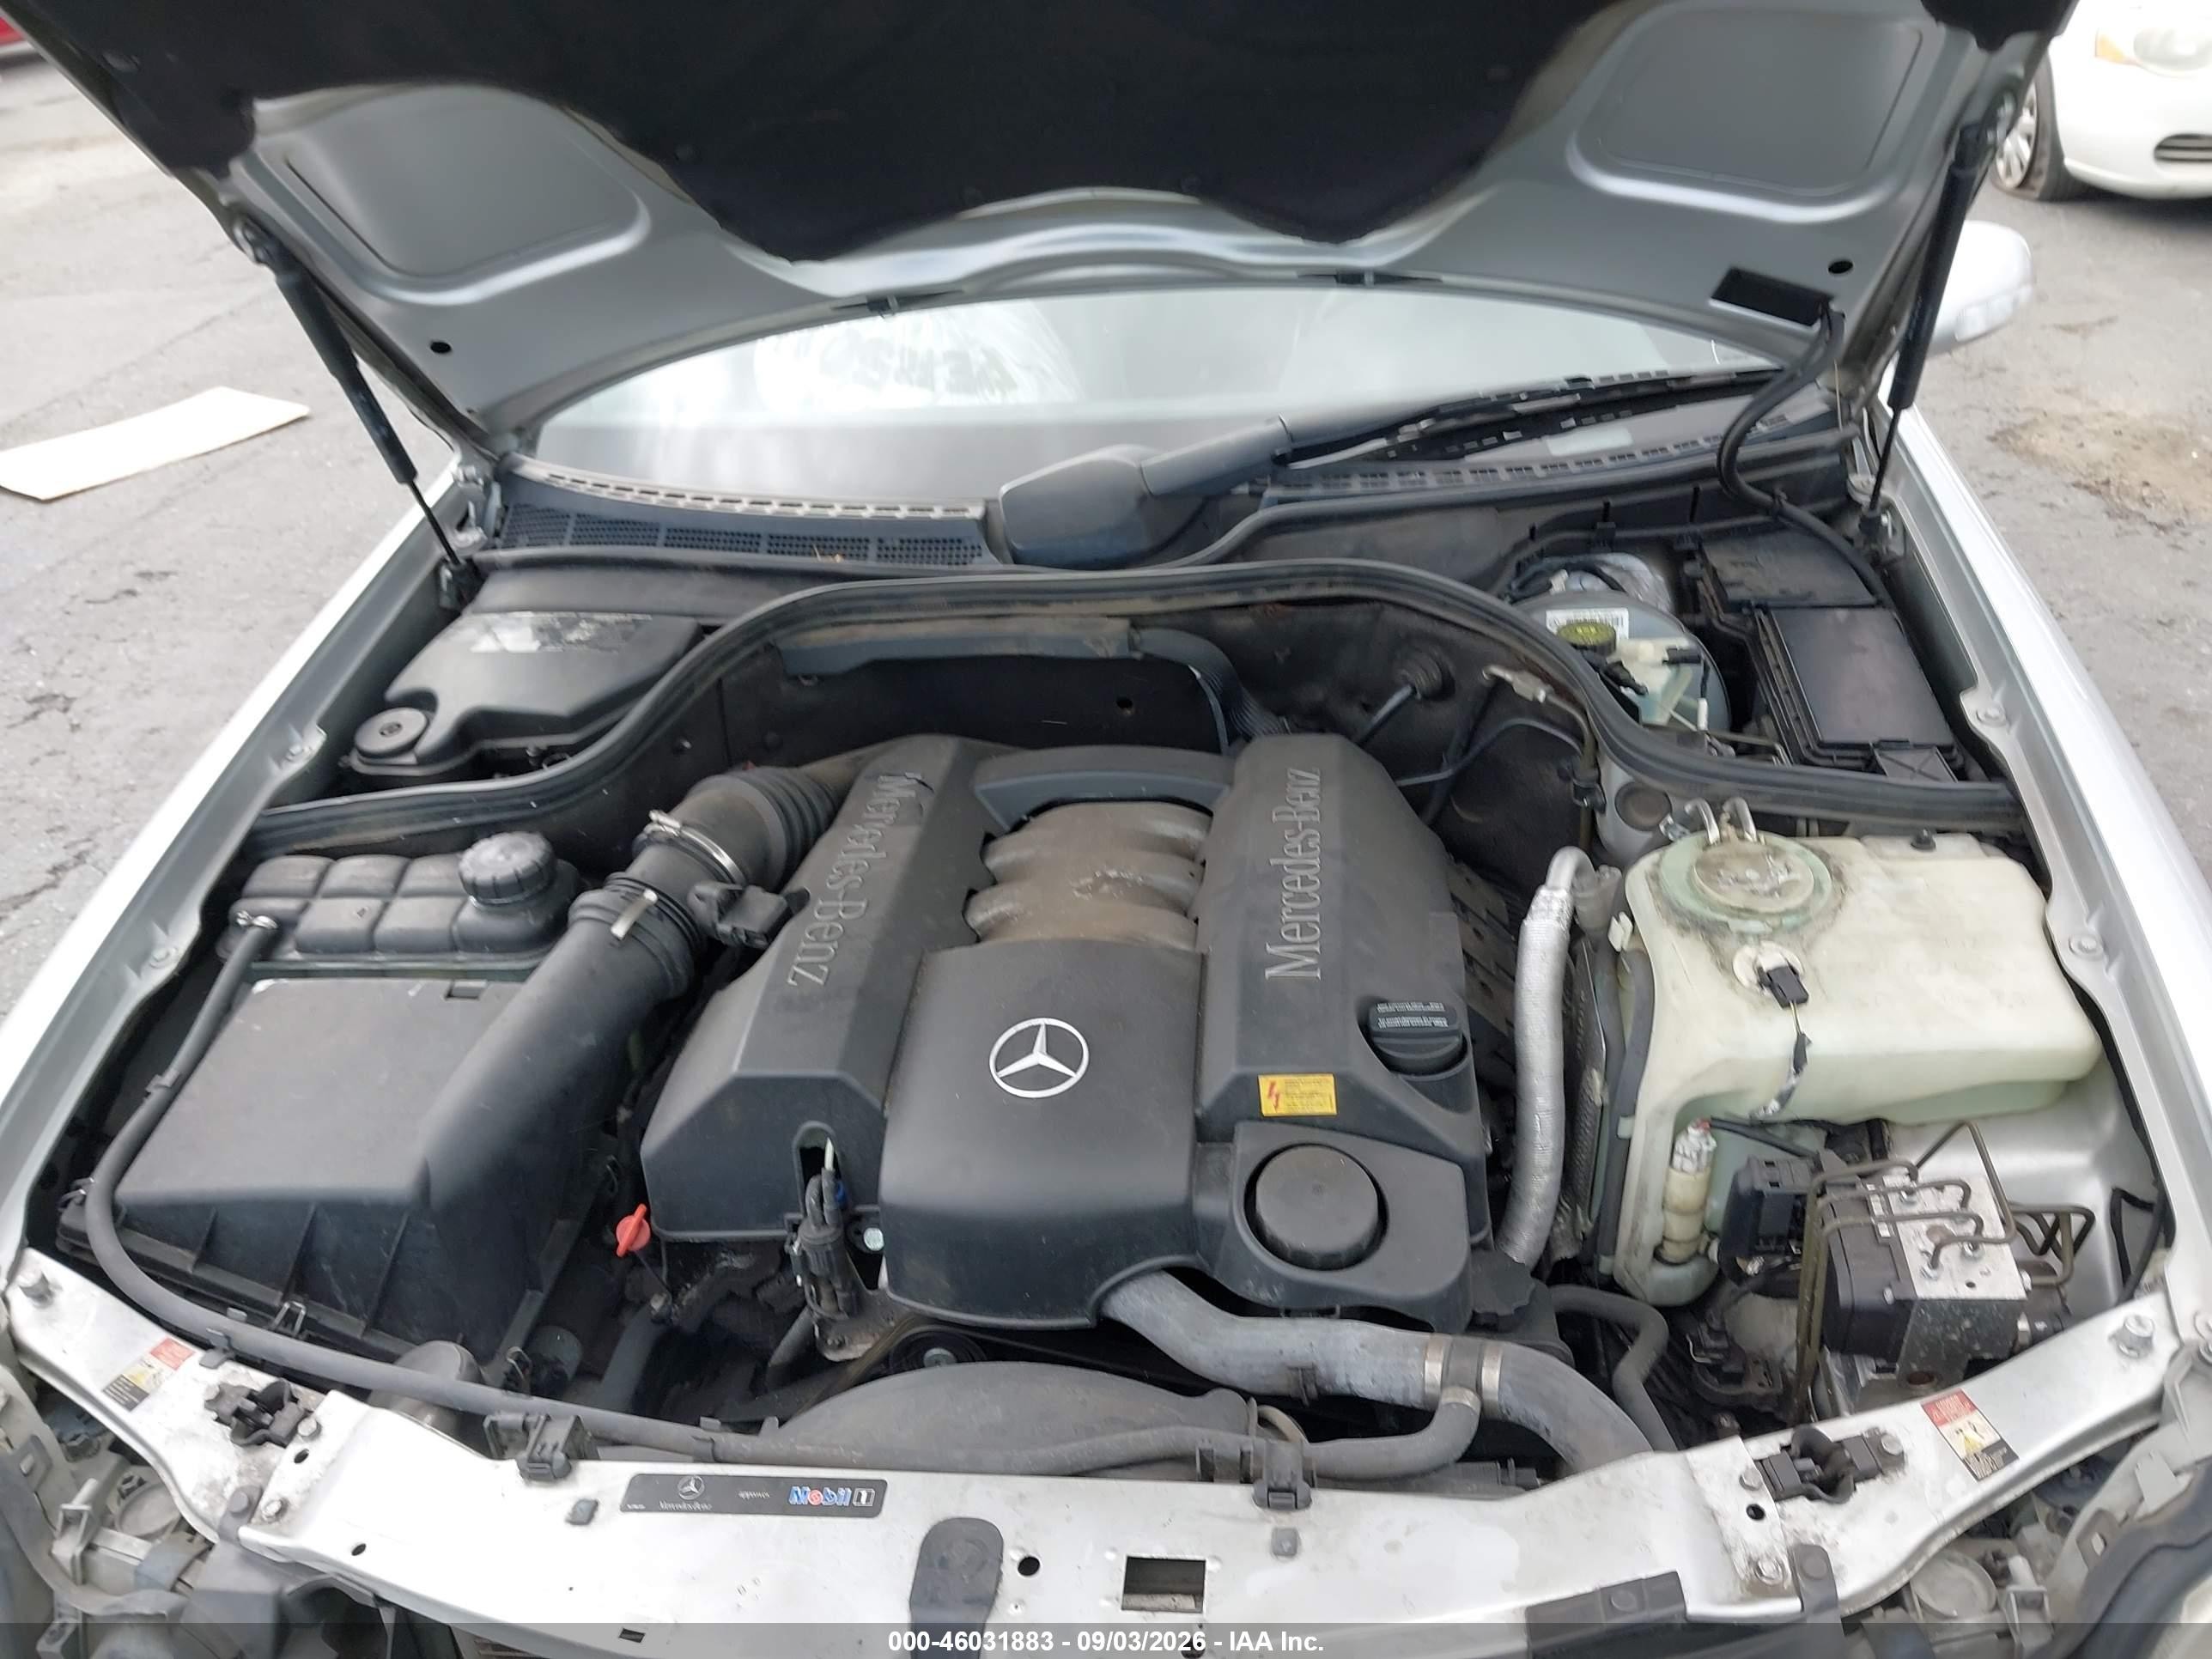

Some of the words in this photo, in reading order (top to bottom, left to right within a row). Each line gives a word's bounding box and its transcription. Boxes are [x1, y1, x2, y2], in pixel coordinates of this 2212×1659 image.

[787, 772, 922, 987] Mercedes-Benz
[1265, 767, 1322, 981] Mercedes-Benz
[788, 1486, 852, 1506] Mobil
